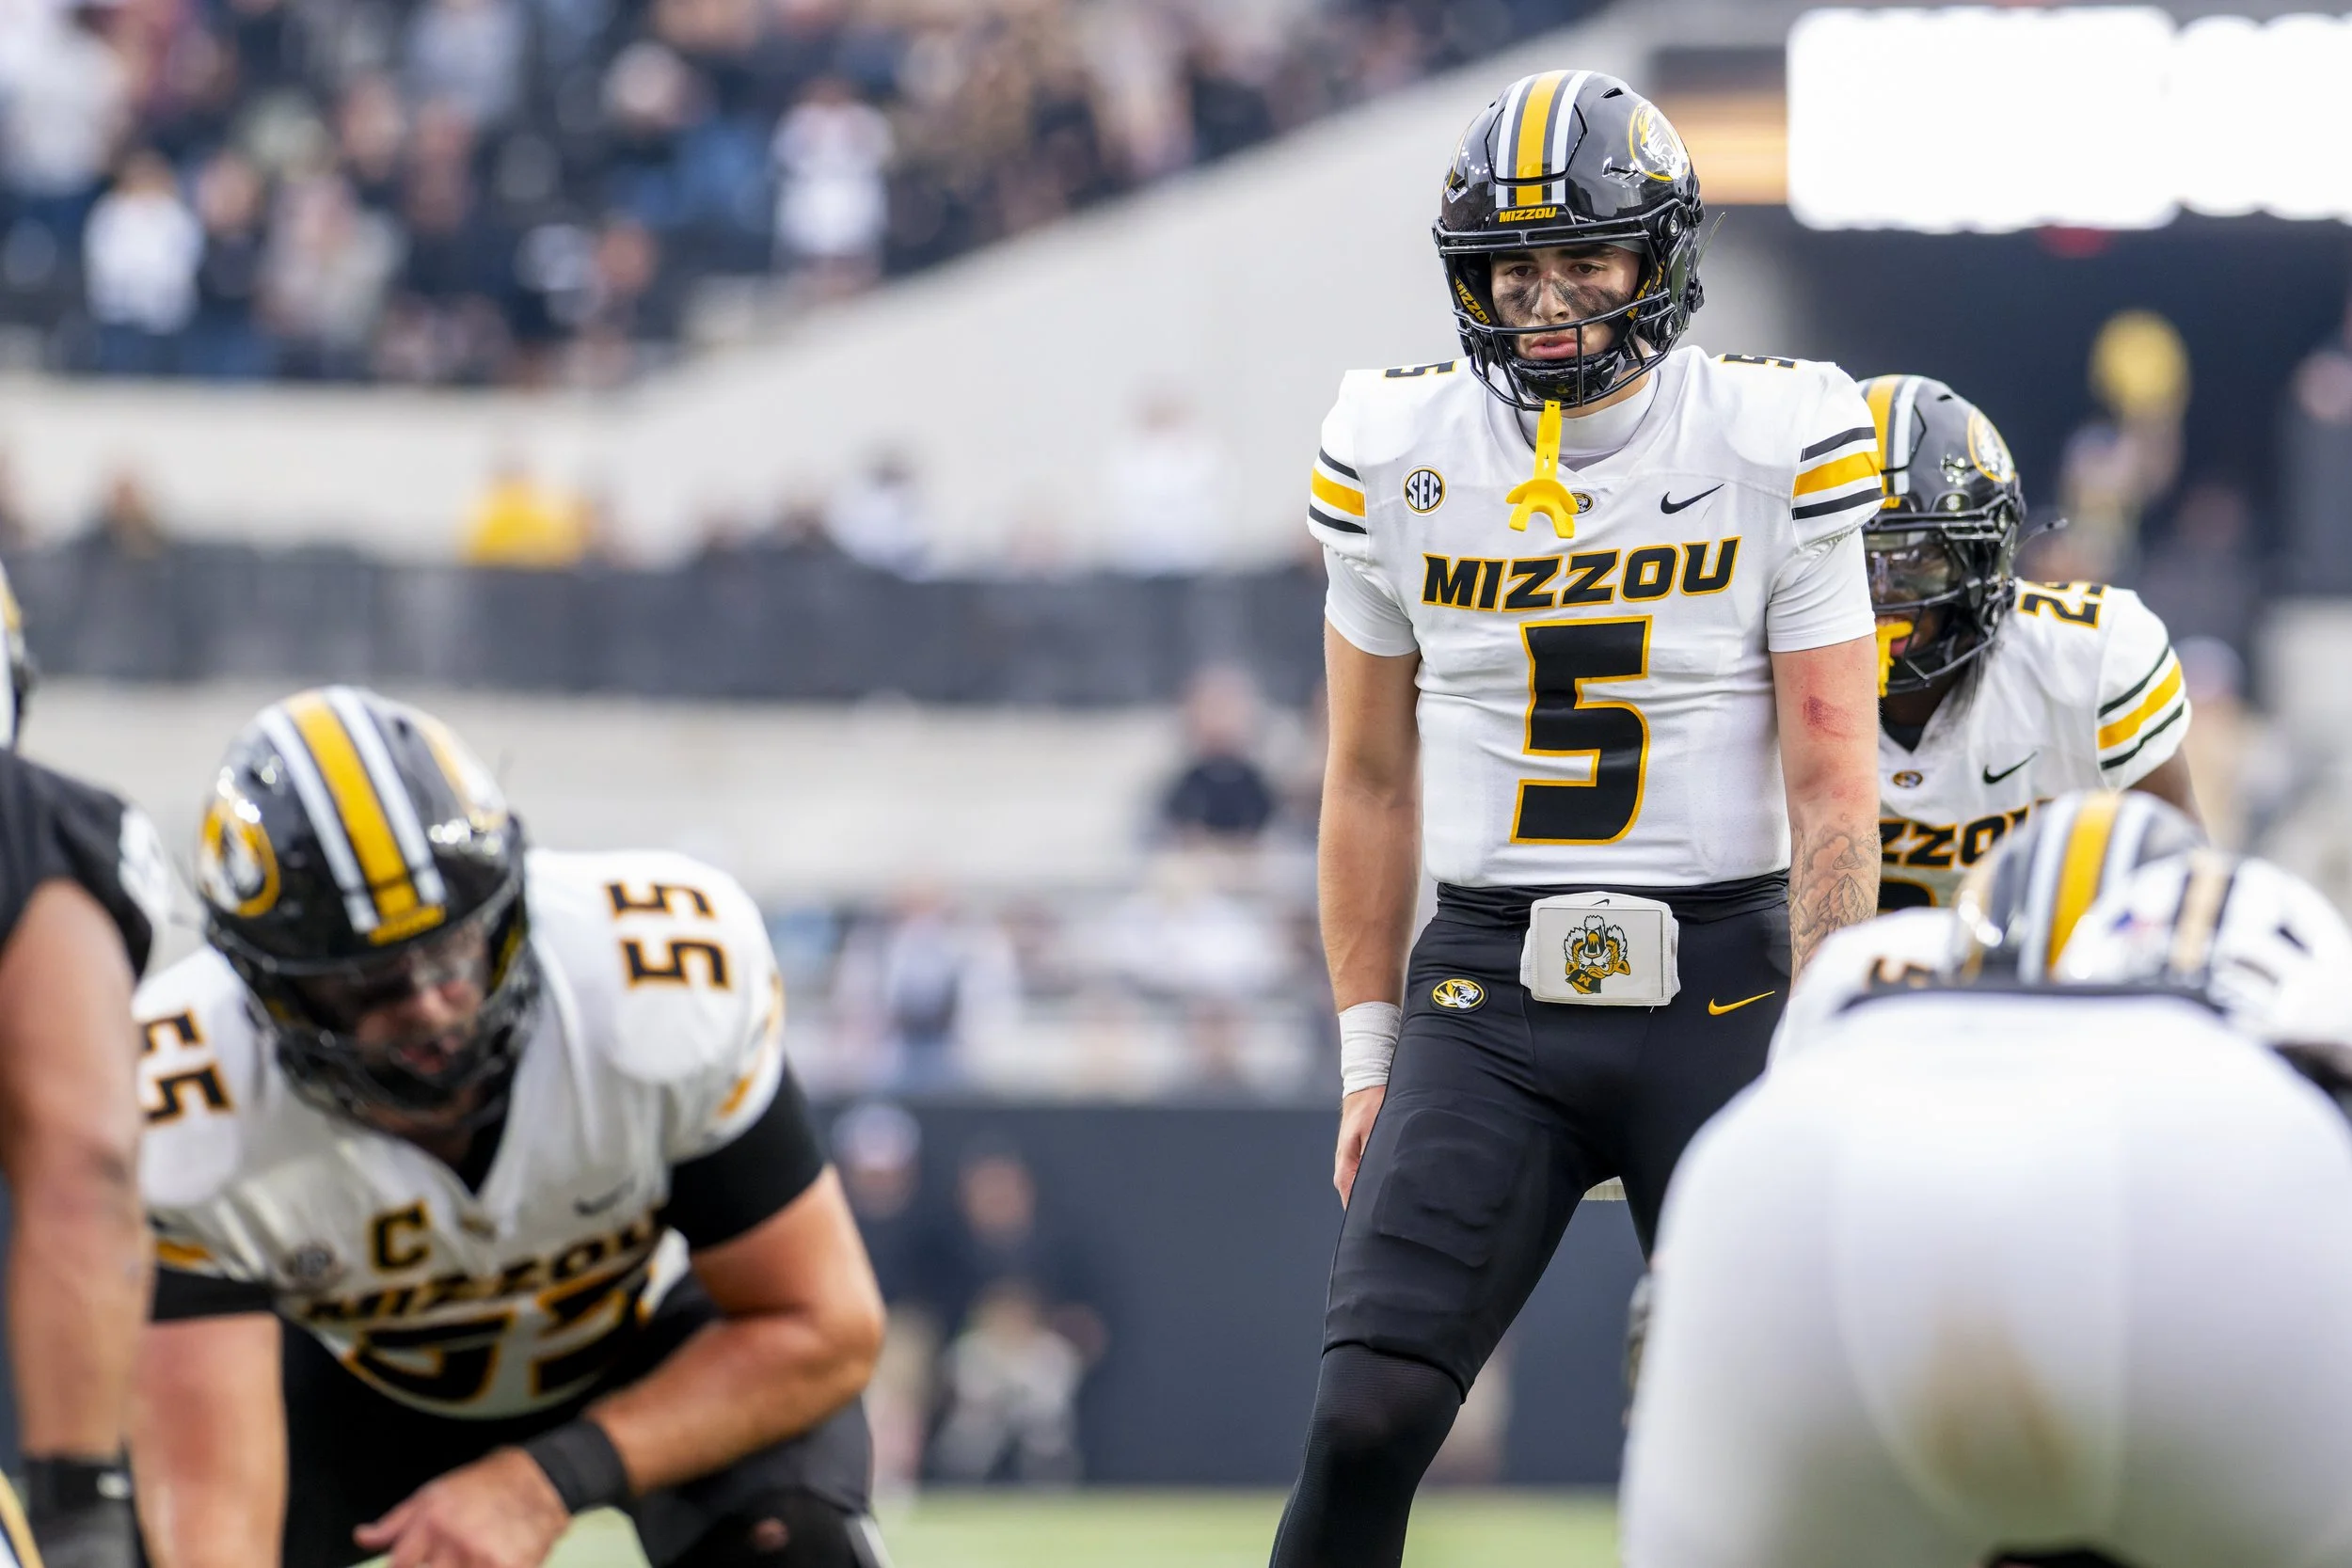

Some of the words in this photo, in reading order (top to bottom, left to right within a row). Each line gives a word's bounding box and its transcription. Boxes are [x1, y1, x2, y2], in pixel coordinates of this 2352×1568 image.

[1499, 206, 1557, 223] MIZZOU
[1405, 469, 1443, 510] SEC
[1422, 536, 1742, 612] MIZZOU
[1509, 614, 1653, 844] 5
[605, 879, 731, 990] 55
[373, 1200, 430, 1273] C
